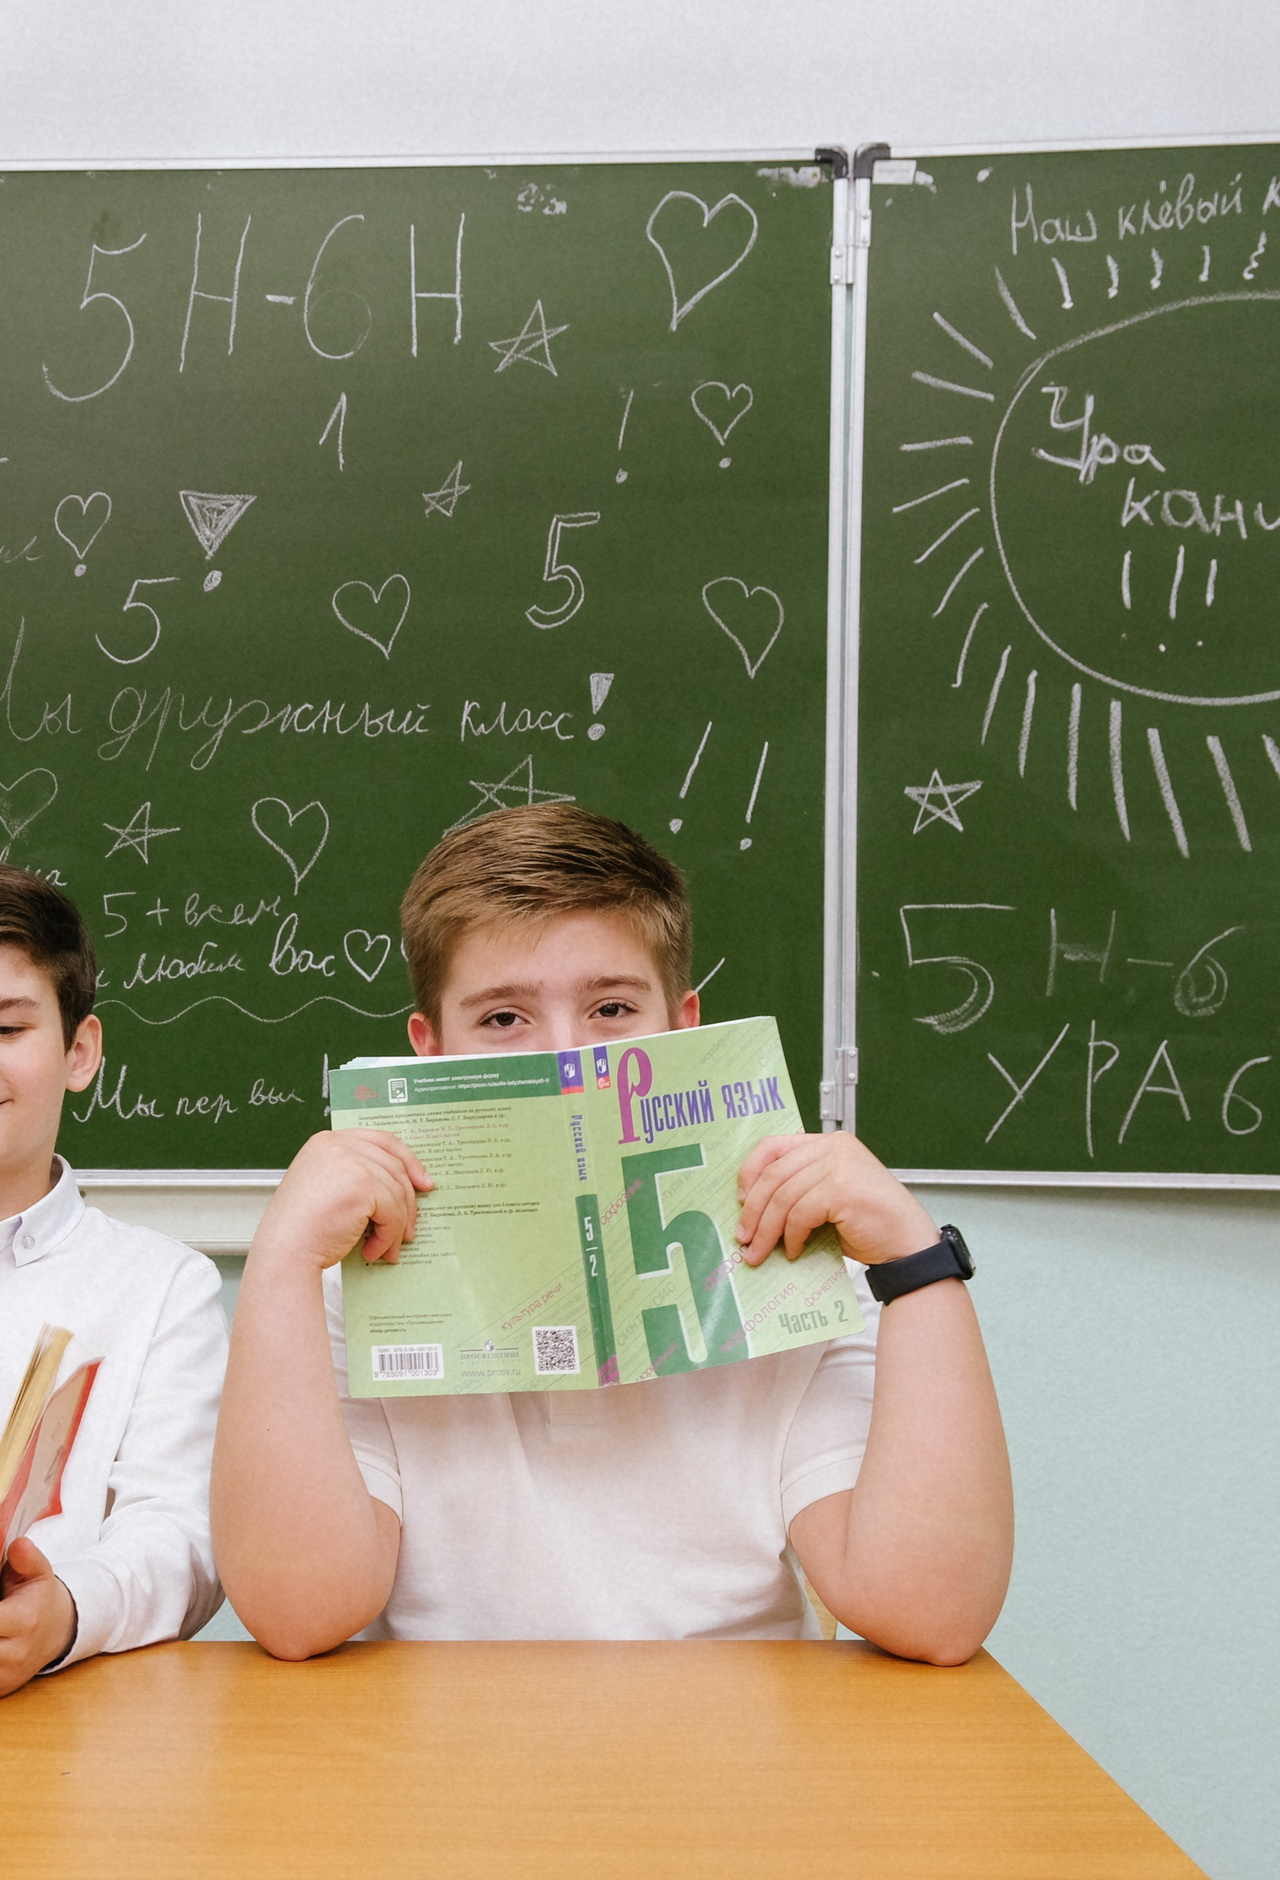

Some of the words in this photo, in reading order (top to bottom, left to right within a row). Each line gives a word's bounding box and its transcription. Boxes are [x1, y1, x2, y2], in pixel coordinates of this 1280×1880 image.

[1011, 182, 1097, 256] Наш
[96, 686, 432, 772] дружный
[72, 1055, 164, 1123] Мы
[778, 1309, 829, 1335] Часть
[834, 1299, 849, 1323] 2
